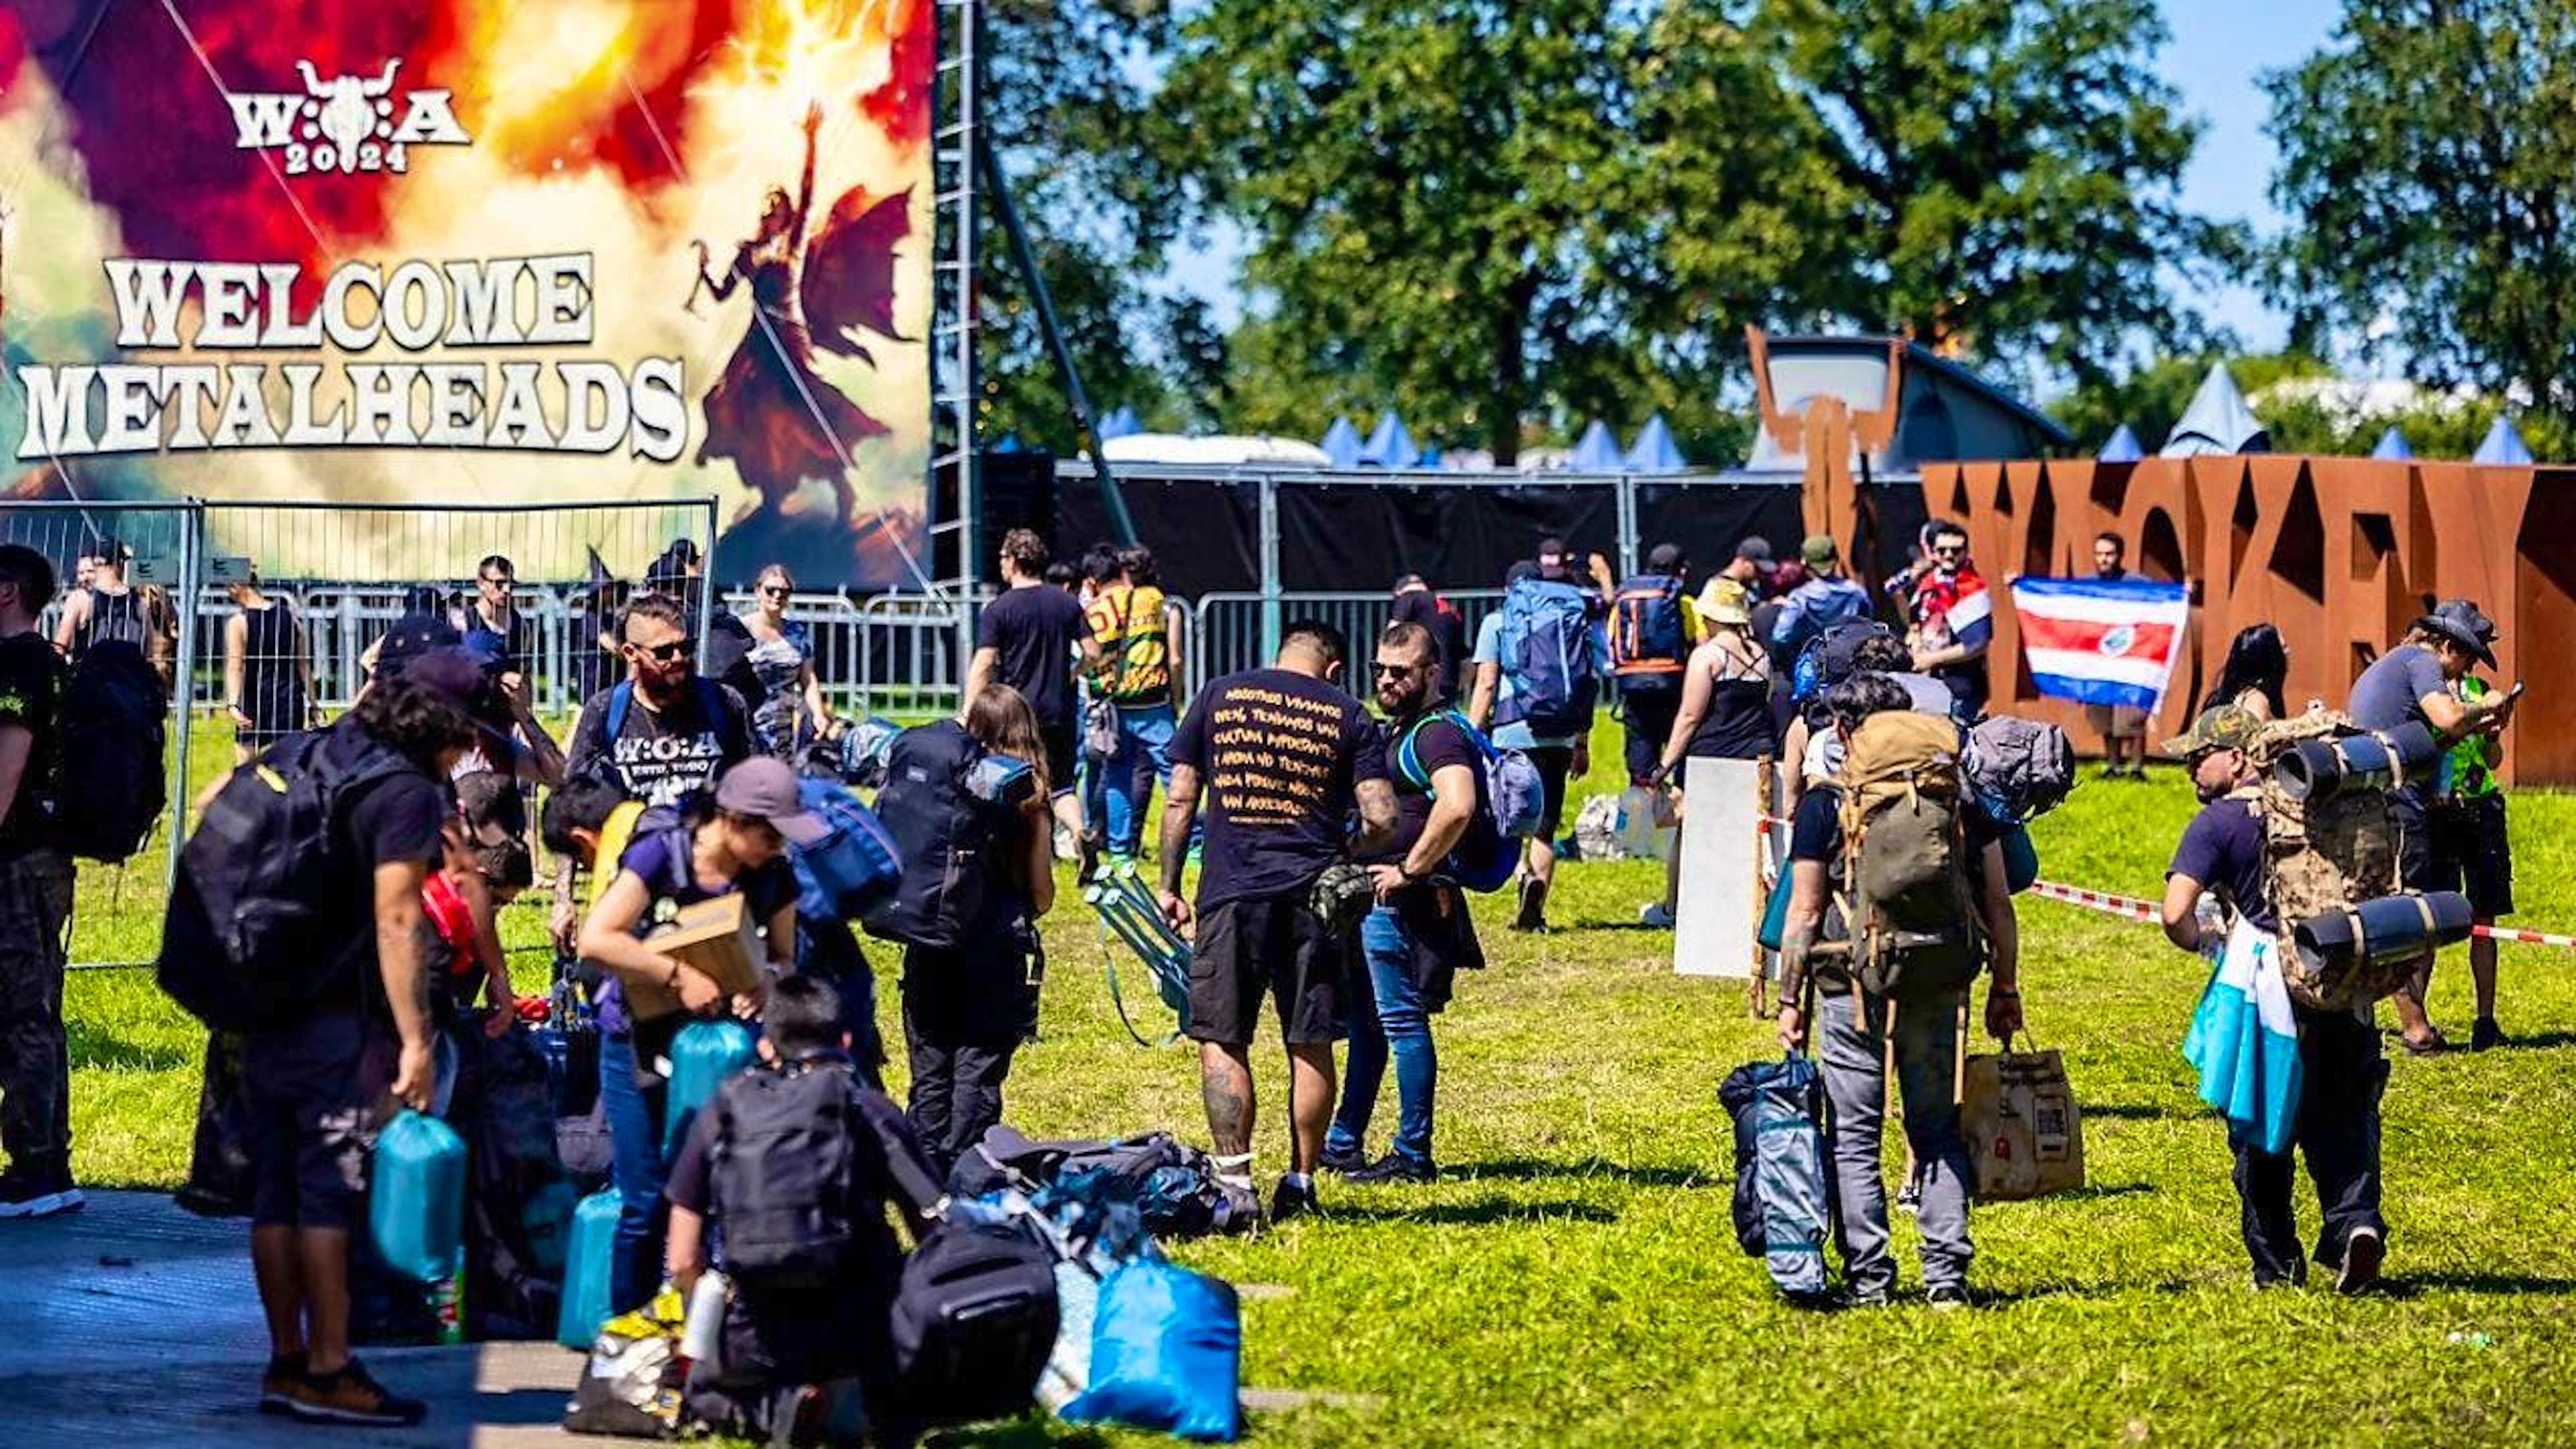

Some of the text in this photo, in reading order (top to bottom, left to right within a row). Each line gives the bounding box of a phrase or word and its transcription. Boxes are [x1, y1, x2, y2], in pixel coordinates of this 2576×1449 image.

[285, 142, 406, 174] 2024
[103, 253, 594, 351] WELCOME
[17, 358, 688, 463] METALHEADS
